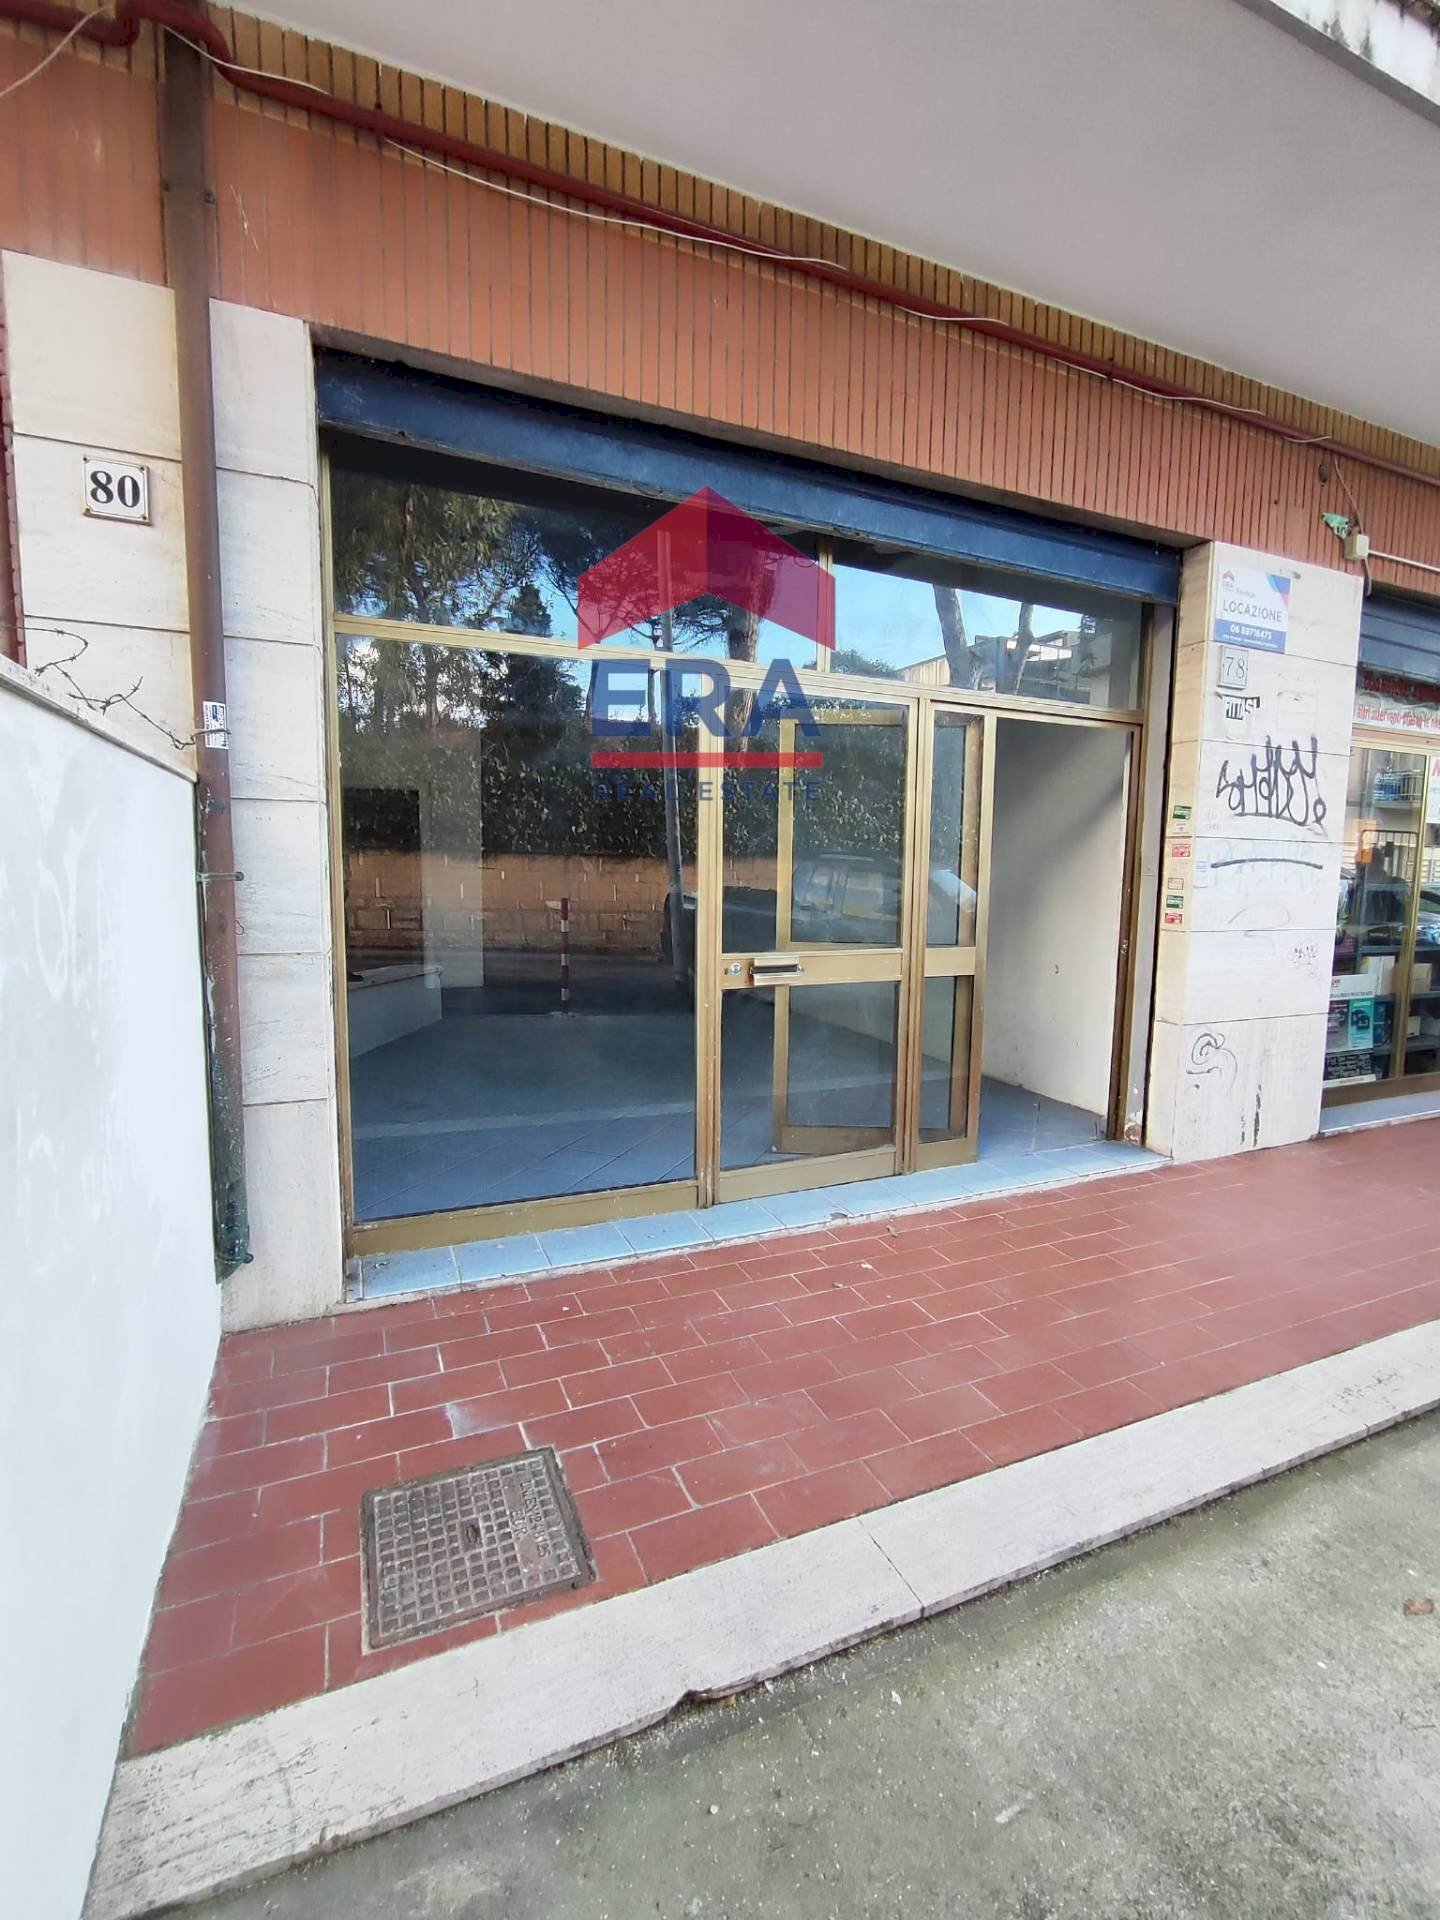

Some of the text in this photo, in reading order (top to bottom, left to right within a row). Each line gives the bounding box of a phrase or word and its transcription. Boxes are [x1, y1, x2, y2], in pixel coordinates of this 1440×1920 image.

[90, 470, 141, 508] 80
[1223, 600, 1282, 622] LOCAZIONE
[1230, 624, 1240, 634] 06
[1226, 656, 1245, 679] 78
